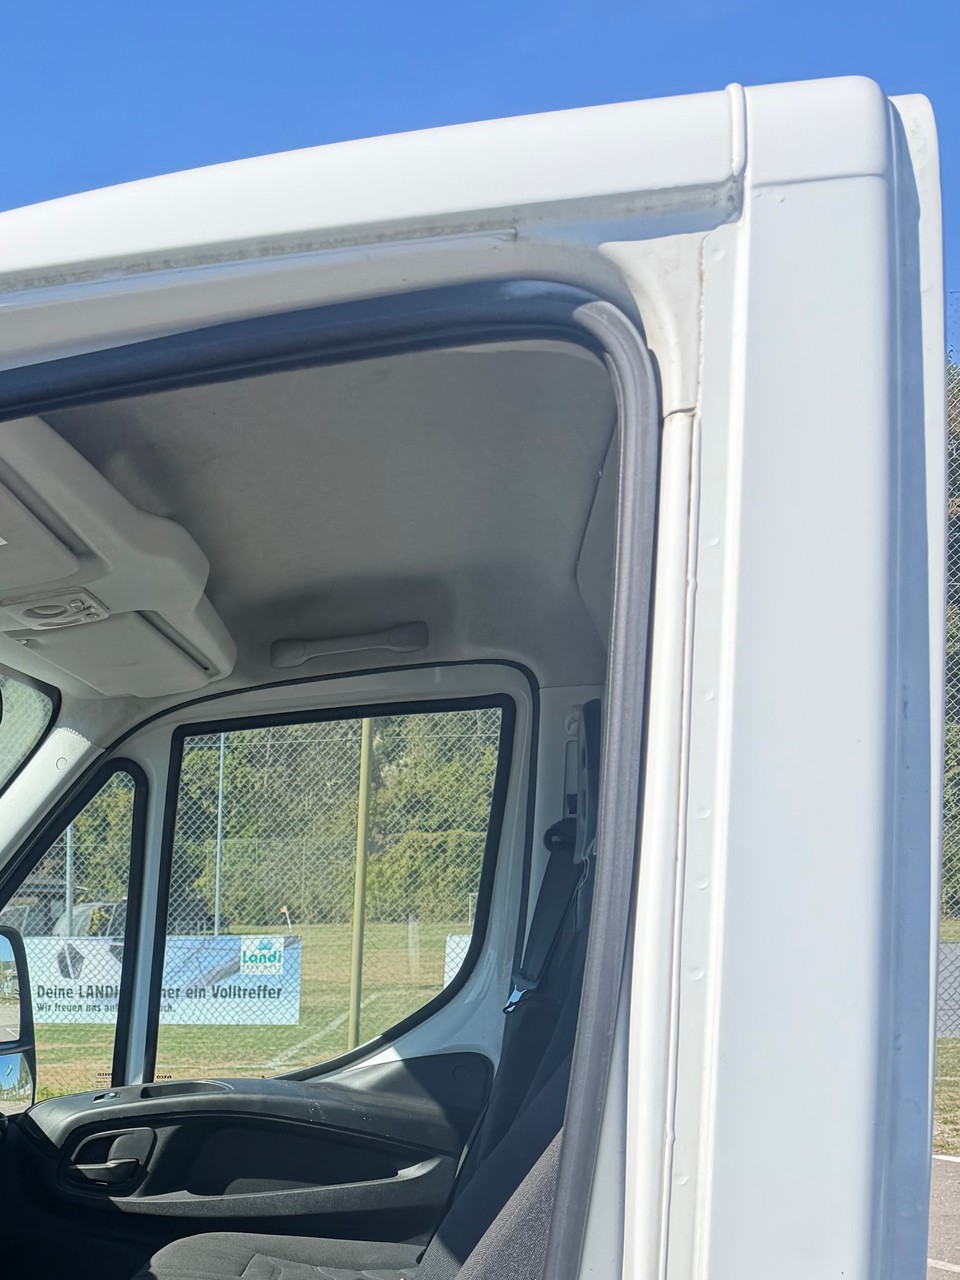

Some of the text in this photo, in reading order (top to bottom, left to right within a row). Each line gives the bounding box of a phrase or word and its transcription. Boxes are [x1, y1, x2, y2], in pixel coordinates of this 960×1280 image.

[242, 950, 282, 964] Landi
[37, 984, 118, 999] Deine LANDI
[186, 984, 207, 999] ein
[211, 984, 283, 1000] Volltreffer
[36, 1002, 52, 1012] Wir
[54, 1002, 83, 1013] freuen
[86, 1004, 102, 1013] uns
